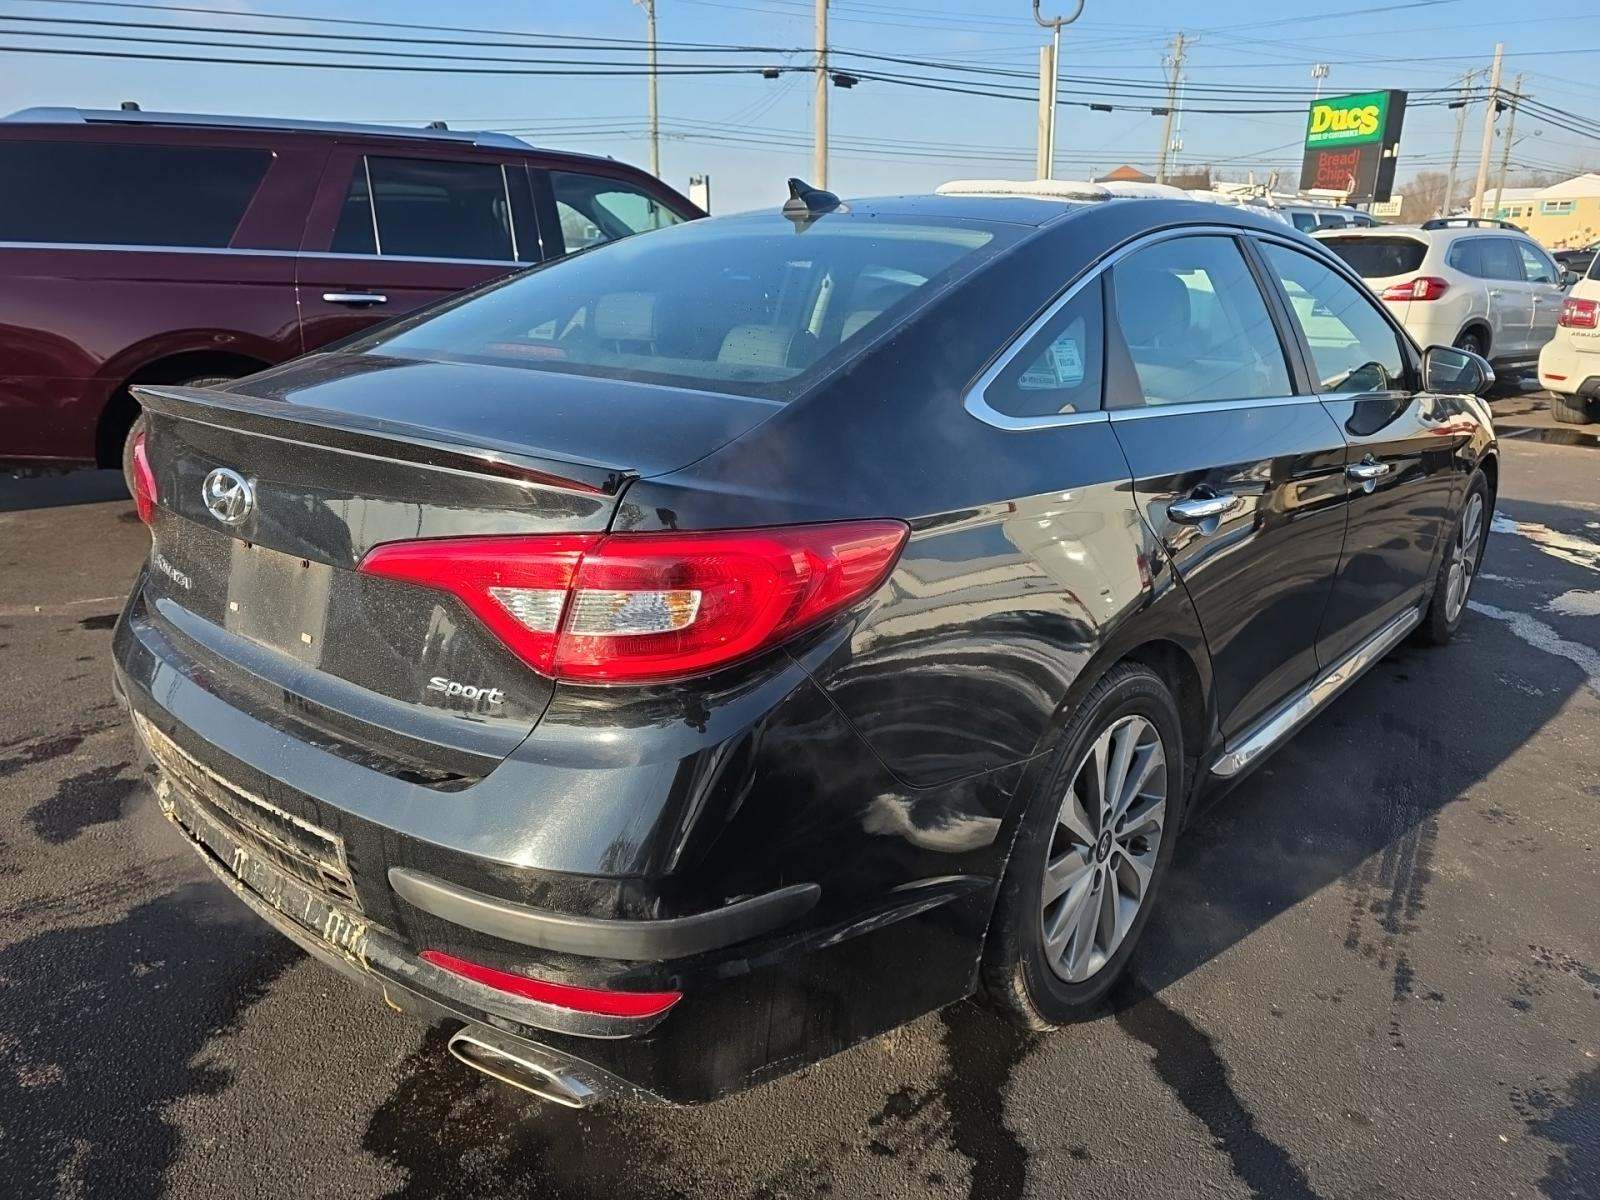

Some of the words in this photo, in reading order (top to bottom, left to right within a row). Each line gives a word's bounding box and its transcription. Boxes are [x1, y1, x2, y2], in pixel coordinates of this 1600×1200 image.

[1310, 105, 1379, 135] Ducs
[1318, 147, 1360, 167] Bread!
[427, 677, 505, 704] Sport
